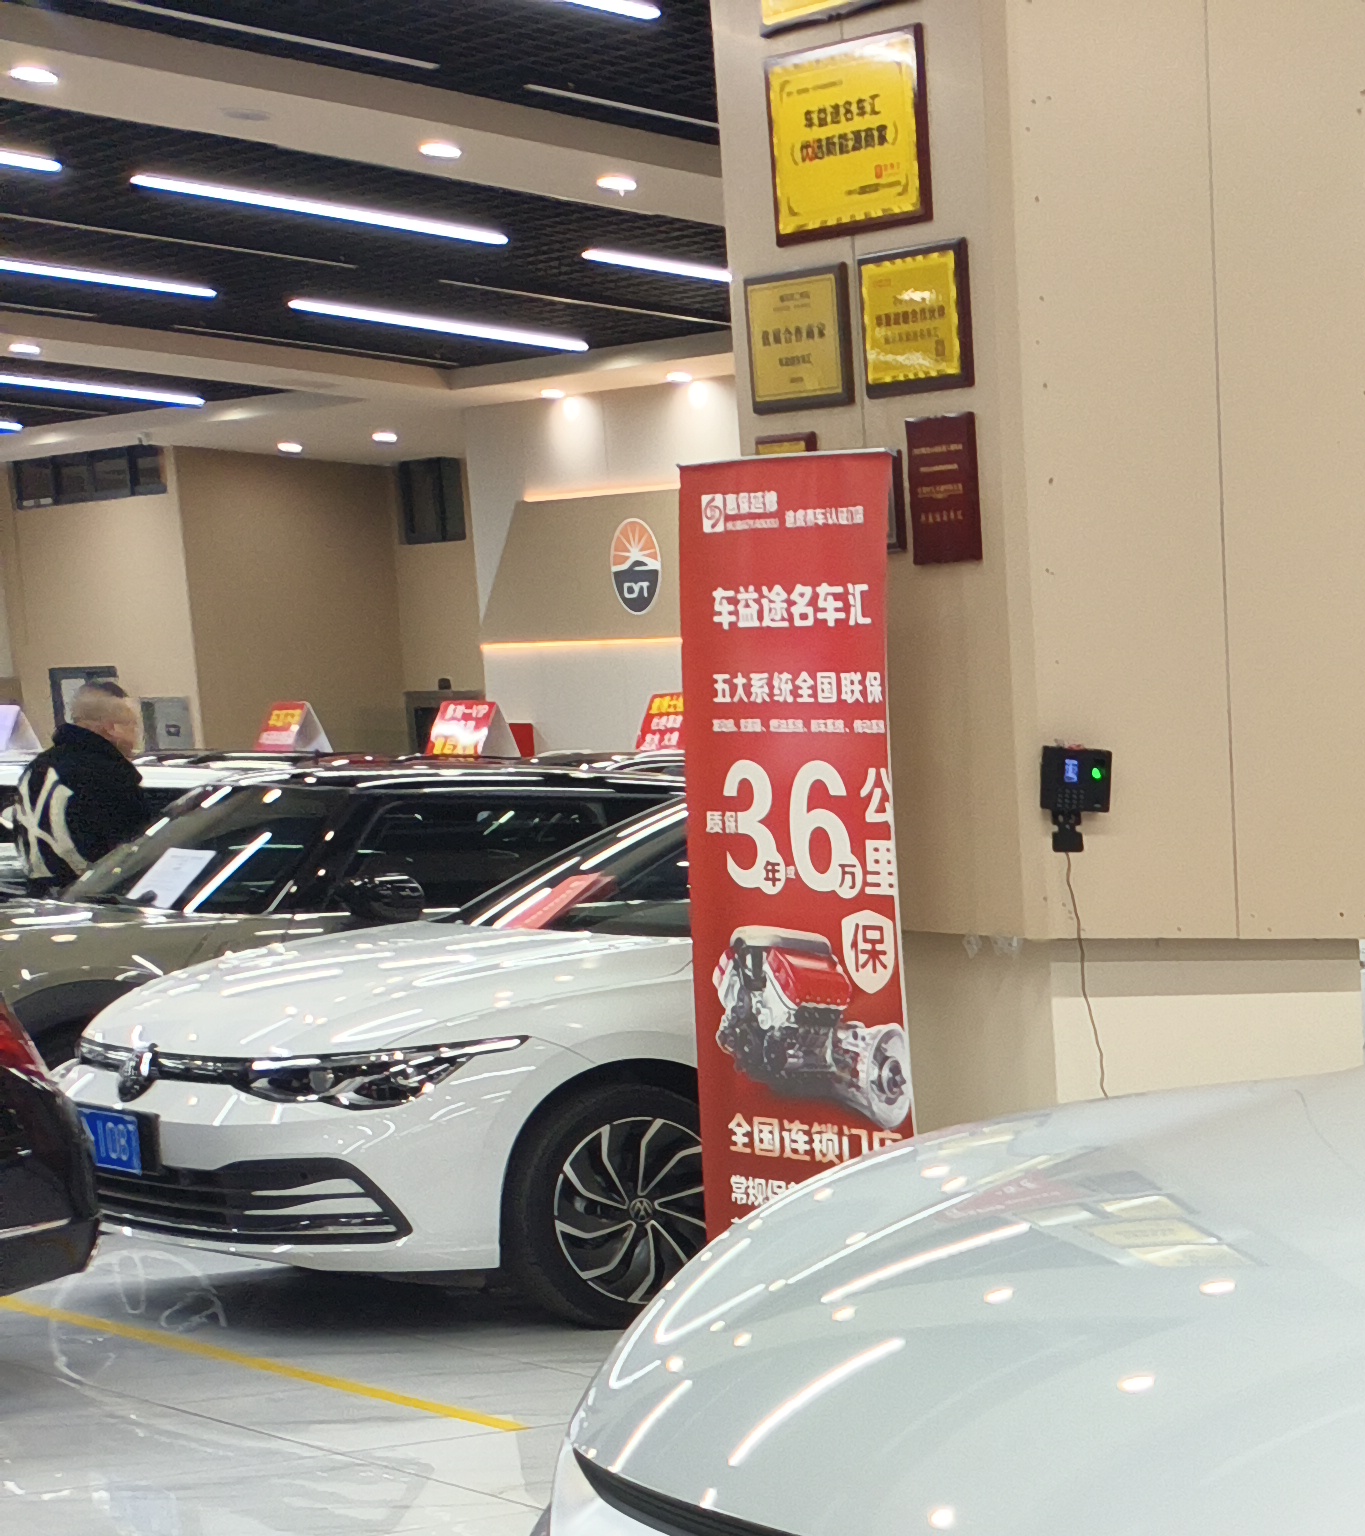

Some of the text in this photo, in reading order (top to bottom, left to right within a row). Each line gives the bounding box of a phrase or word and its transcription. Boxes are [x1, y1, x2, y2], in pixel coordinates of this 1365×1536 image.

[712, 583, 872, 630] 车益途名车汇
[712, 671, 884, 703] 五大系统全国联保
[851, 923, 888, 973] 保
[730, 1175, 799, 1206] 常规保
